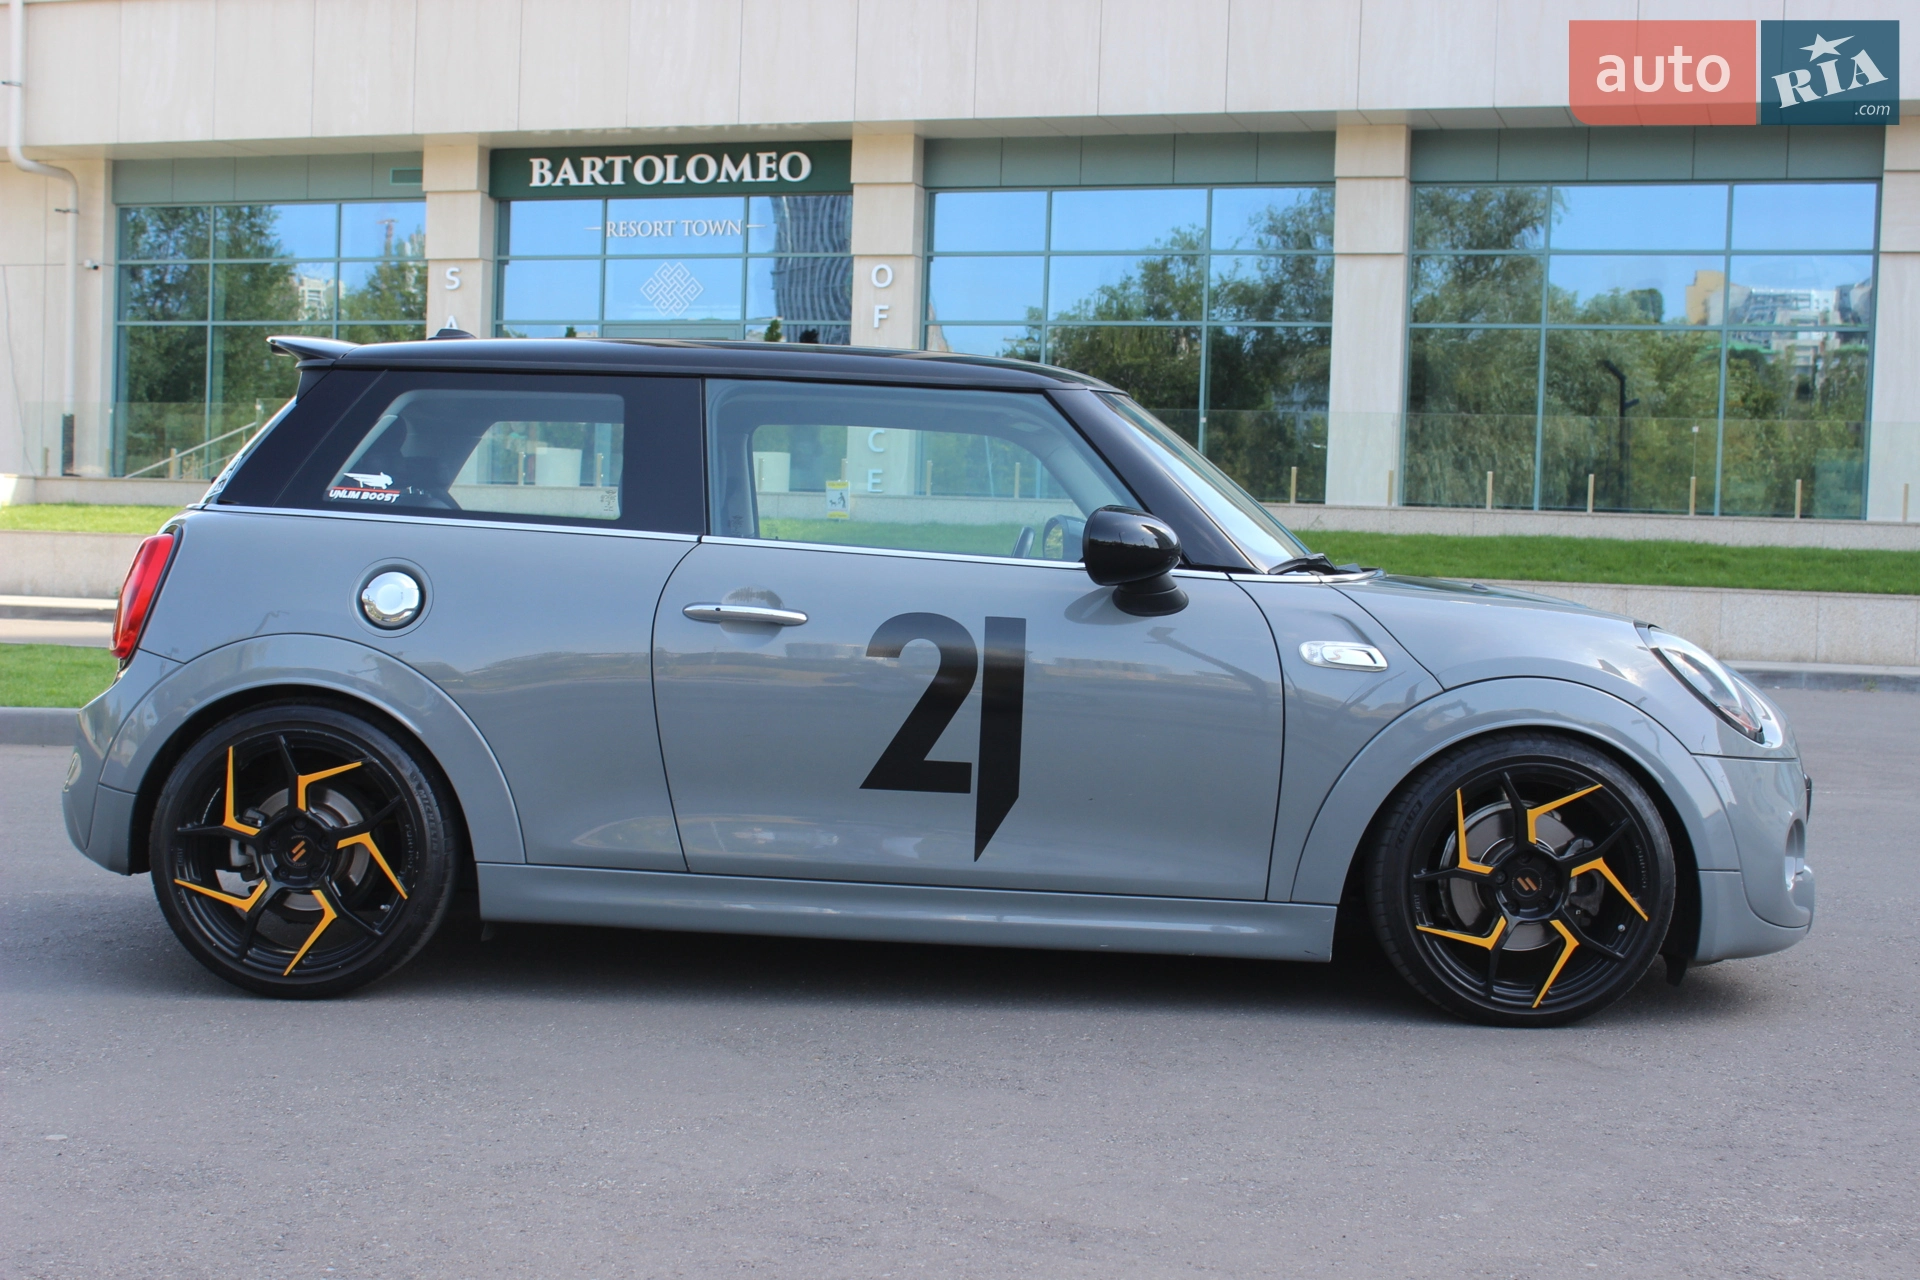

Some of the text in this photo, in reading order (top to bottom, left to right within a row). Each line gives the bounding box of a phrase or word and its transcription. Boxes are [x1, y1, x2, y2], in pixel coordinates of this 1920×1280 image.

[529, 151, 812, 187] BARTOLOMEO
[606, 219, 743, 237] RESORT TOWN
[328, 489, 400, 503] UNLIM BOOST
[859, 612, 1026, 862] 21
